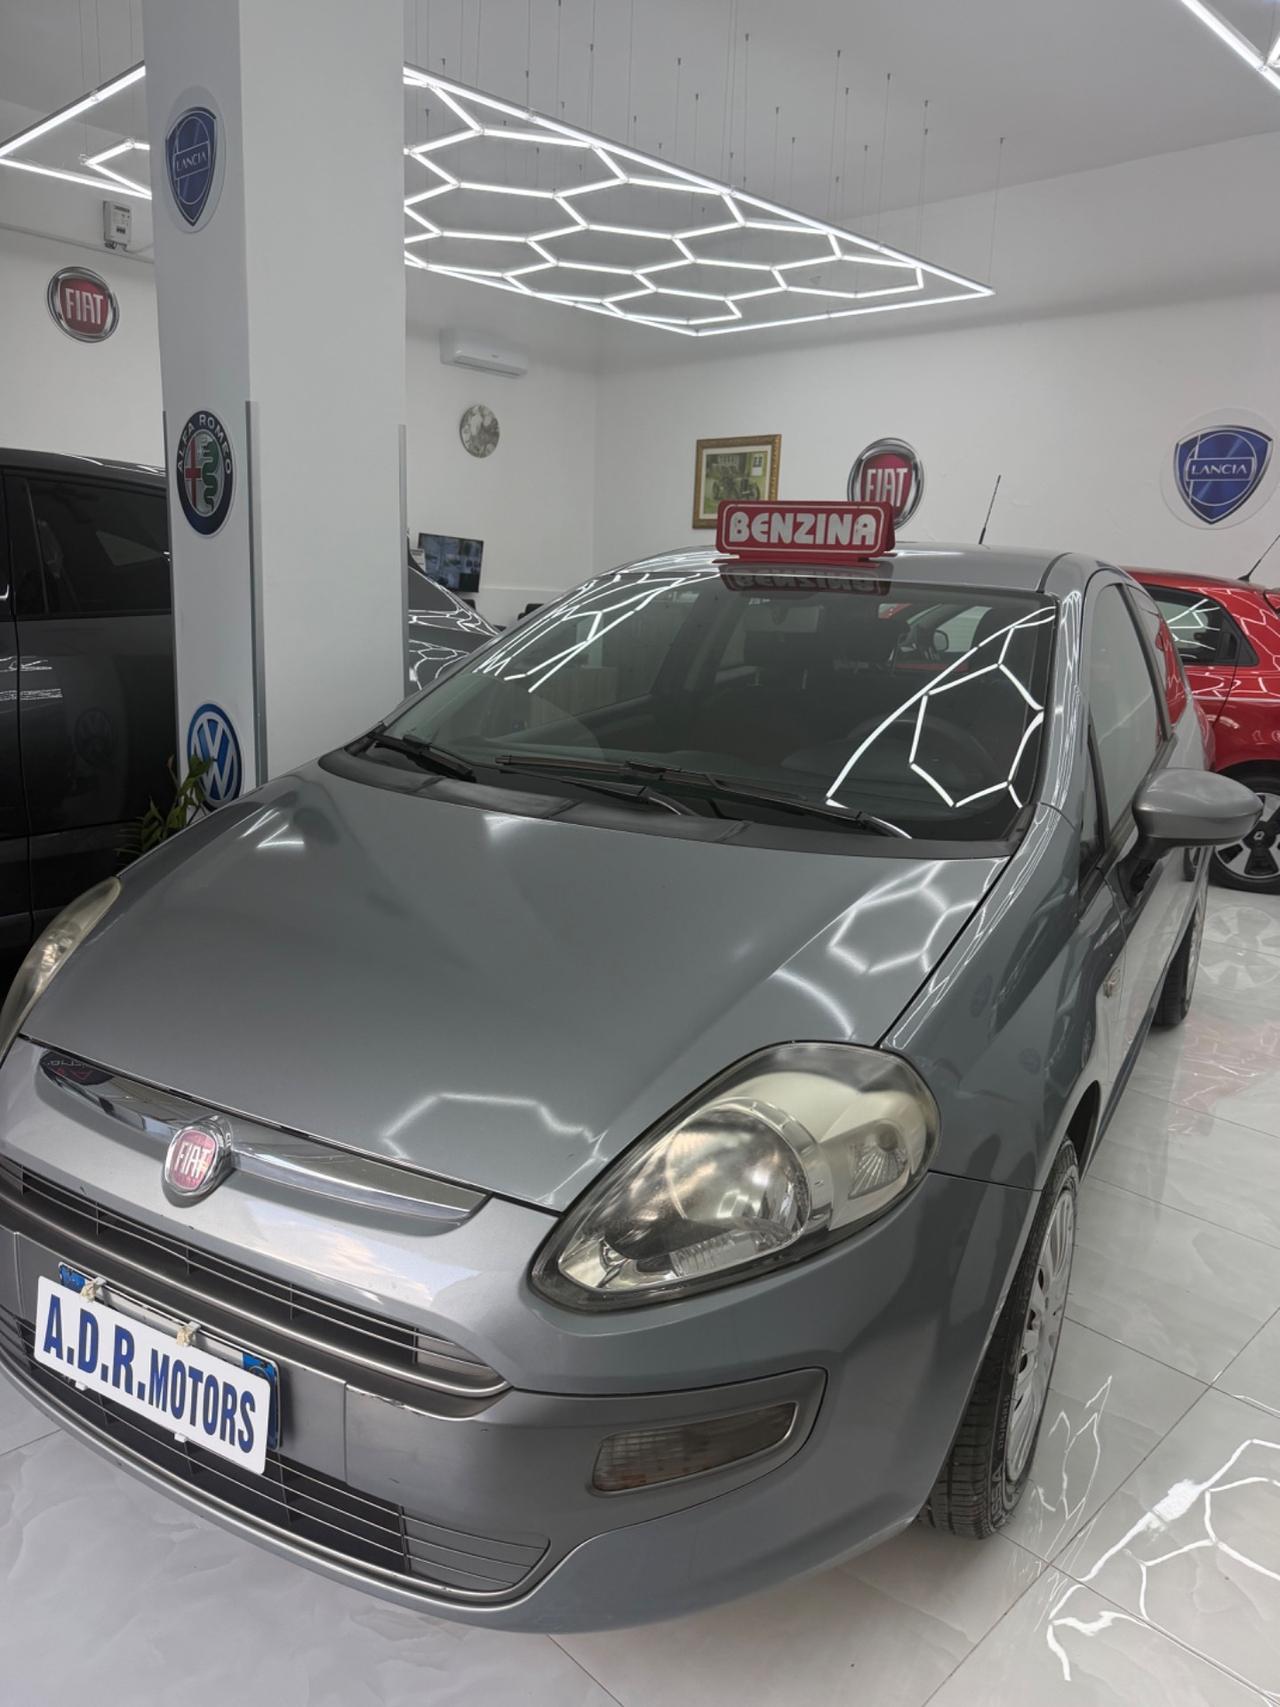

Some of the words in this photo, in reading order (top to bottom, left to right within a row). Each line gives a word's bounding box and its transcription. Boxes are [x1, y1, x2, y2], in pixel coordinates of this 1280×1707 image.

[176, 151, 207, 172] LANCIA
[65, 286, 104, 325] FIAT
[177, 422, 195, 472] ALFA
[199, 414, 232, 475] ROMEO
[865, 467, 908, 506] FIAT
[1191, 463, 1248, 475] LANCIA
[729, 511, 877, 546] BENZINA
[174, 1141, 211, 1179] FIAT
